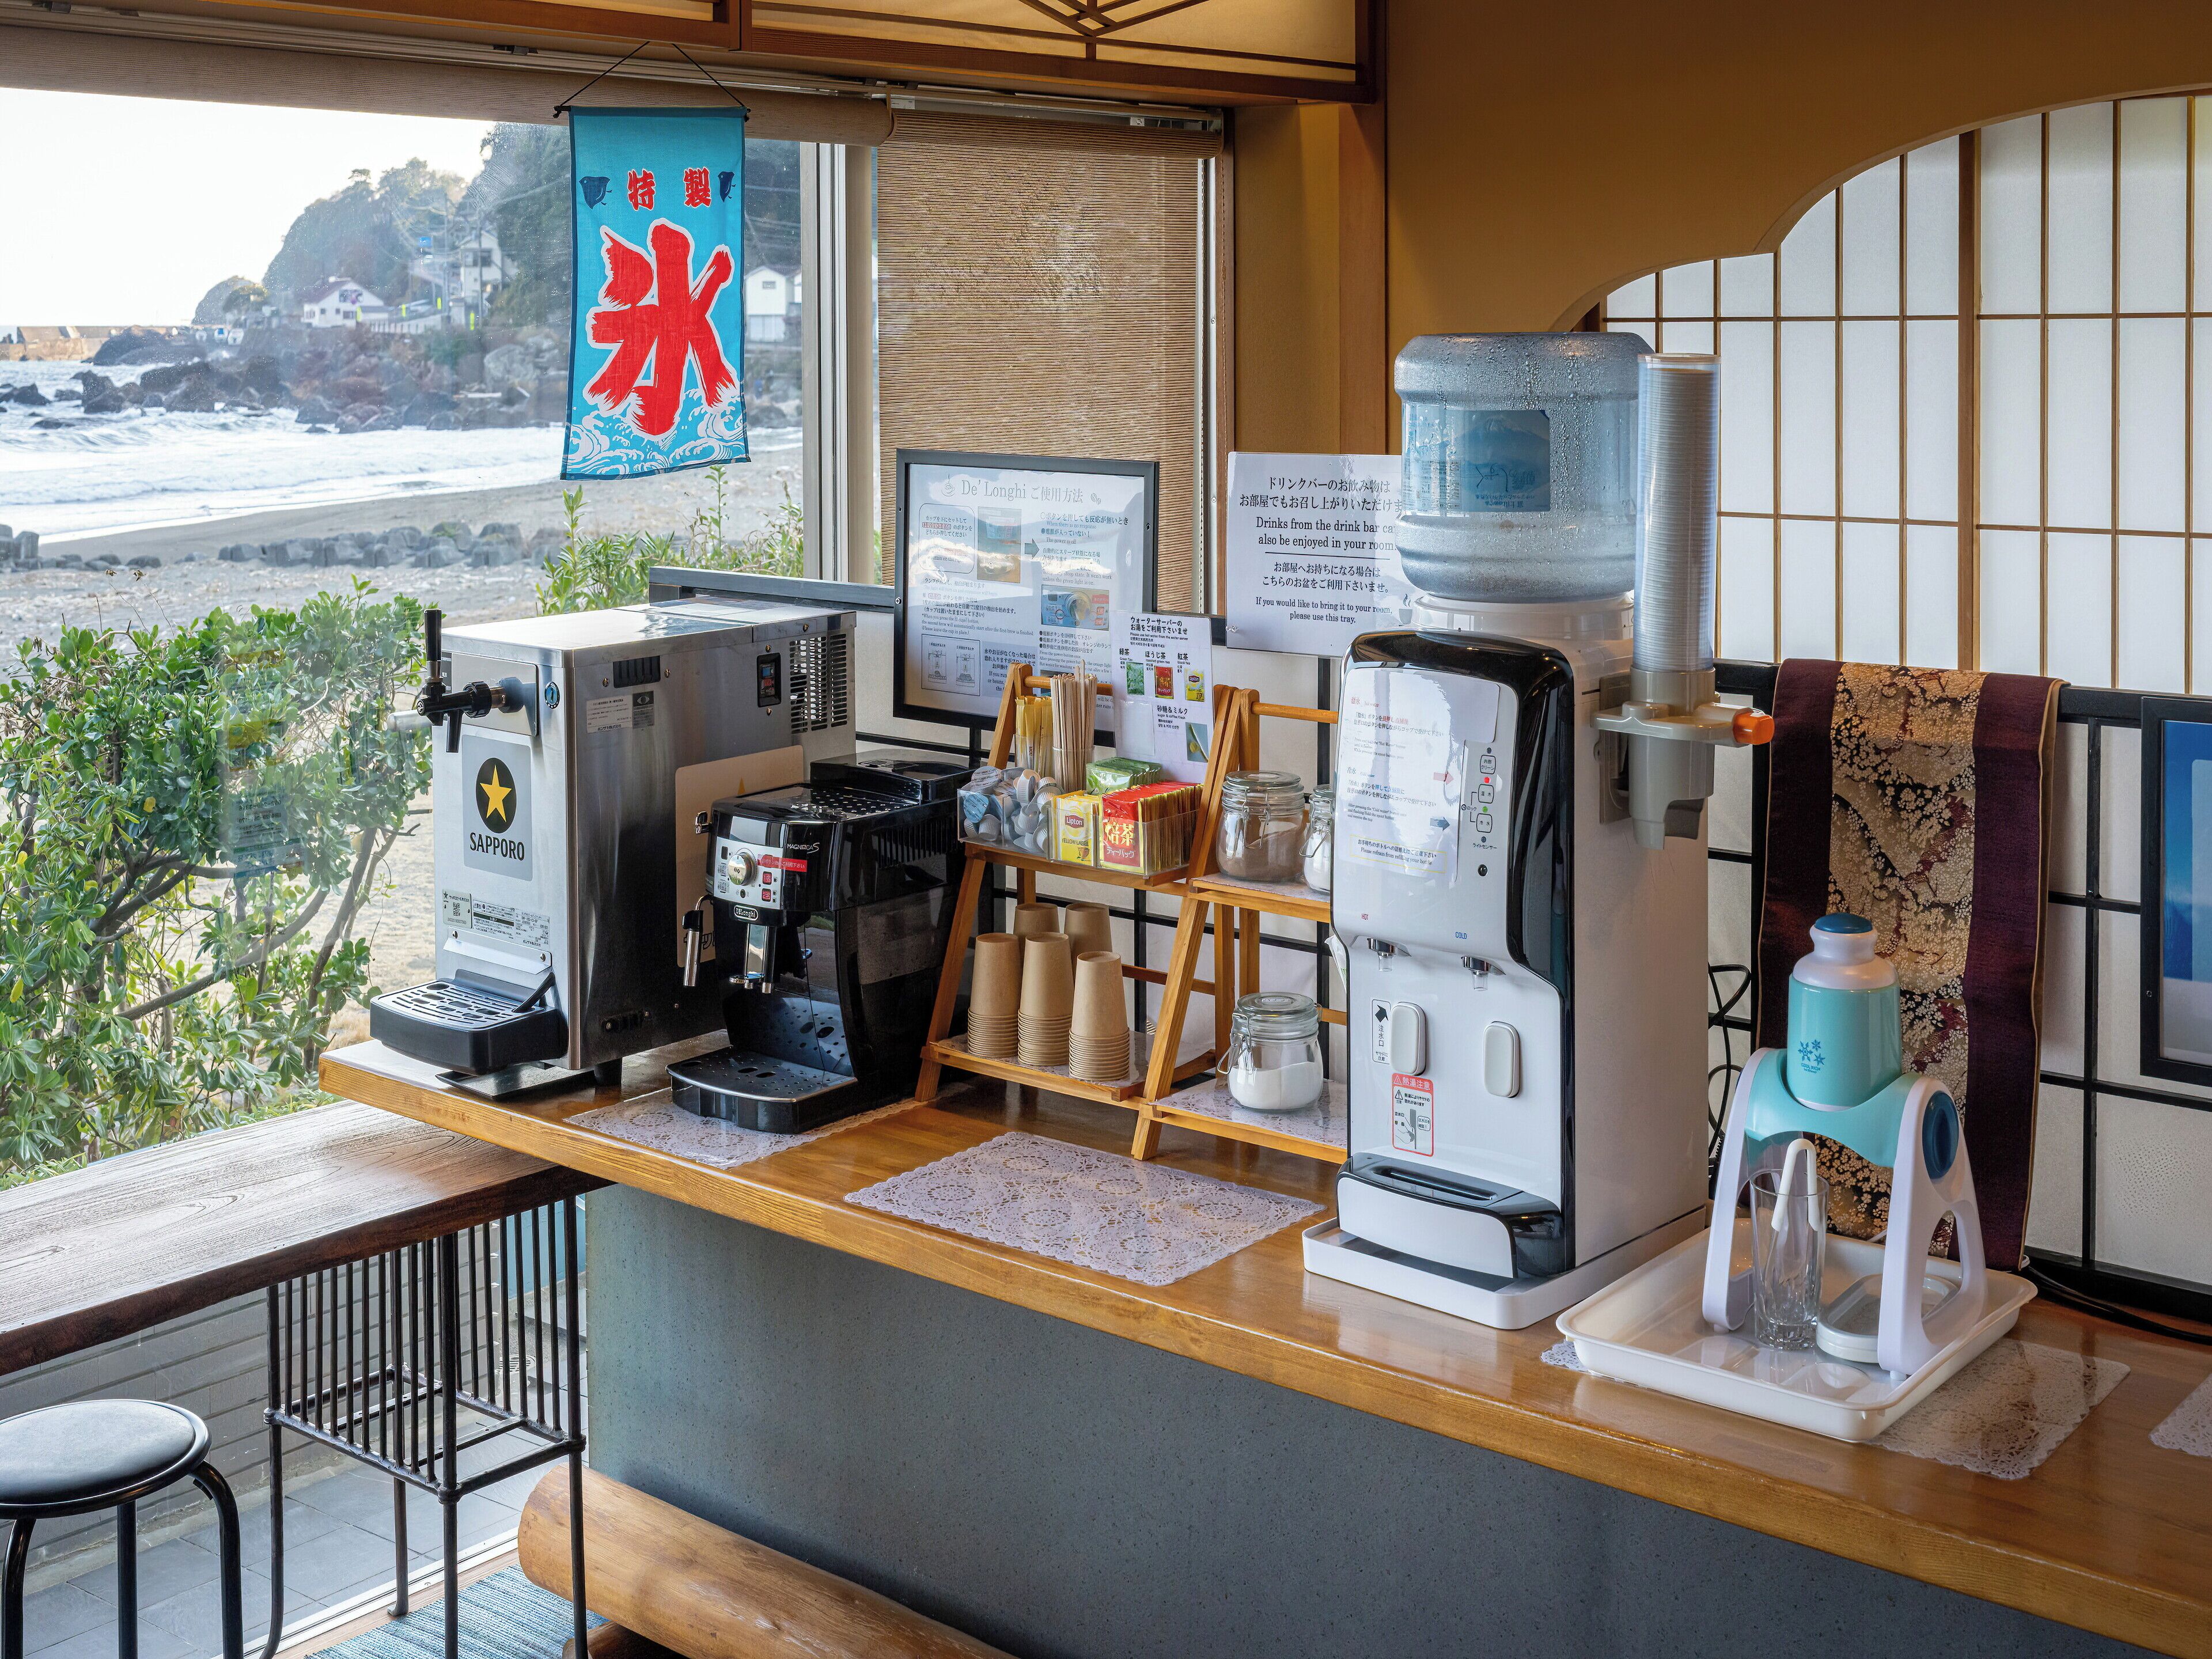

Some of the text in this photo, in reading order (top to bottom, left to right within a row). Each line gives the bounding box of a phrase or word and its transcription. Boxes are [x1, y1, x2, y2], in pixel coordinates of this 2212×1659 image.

[627, 167, 712, 212] 特製
[582, 218, 739, 439] 氷
[1269, 476, 1391, 494] ドリンクバーのお飲み物は
[1031, 486, 1083, 503] ご使用方法
[1240, 494, 1402, 514] お部屋でもお召し上がりいただけま
[1256, 517, 1395, 533] Drinks from the drink bar ca
[1258, 533, 1397, 551] also be enjoyed in your room.
[1274, 562, 1380, 577] お部屋へお持ちになる場合は
[1262, 576, 1388, 593] こちらのお盆をご利用下さいませ。
[1256, 597, 1262, 605] If
[1263, 598, 1274, 607] you
[1276, 599, 1296, 607] would
[1298, 599, 1310, 608] like
[1312, 601, 1318, 609] to
[1320, 601, 1338, 612] bring
[1340, 602, 1346, 610] it
[1355, 604, 1371, 613] your
[1373, 606, 1393, 615] room,
[1130, 616, 1183, 627] ウォーターサーバーの
[1289, 611, 1310, 620] please
[1325, 613, 1339, 622] this
[1340, 615, 1356, 623] tray.
[1130, 624, 1188, 635] お湯をご利用下さいませ
[1145, 651, 1166, 660] ほうじ茶
[1157, 705, 1188, 715] 砂糖&ミルク
[1066, 817, 1082, 826] Lipton
[469, 832, 525, 861] SAPPORO
[1106, 846, 1136, 858] ティーバッグ
[1455, 931, 1467, 940] COLD
